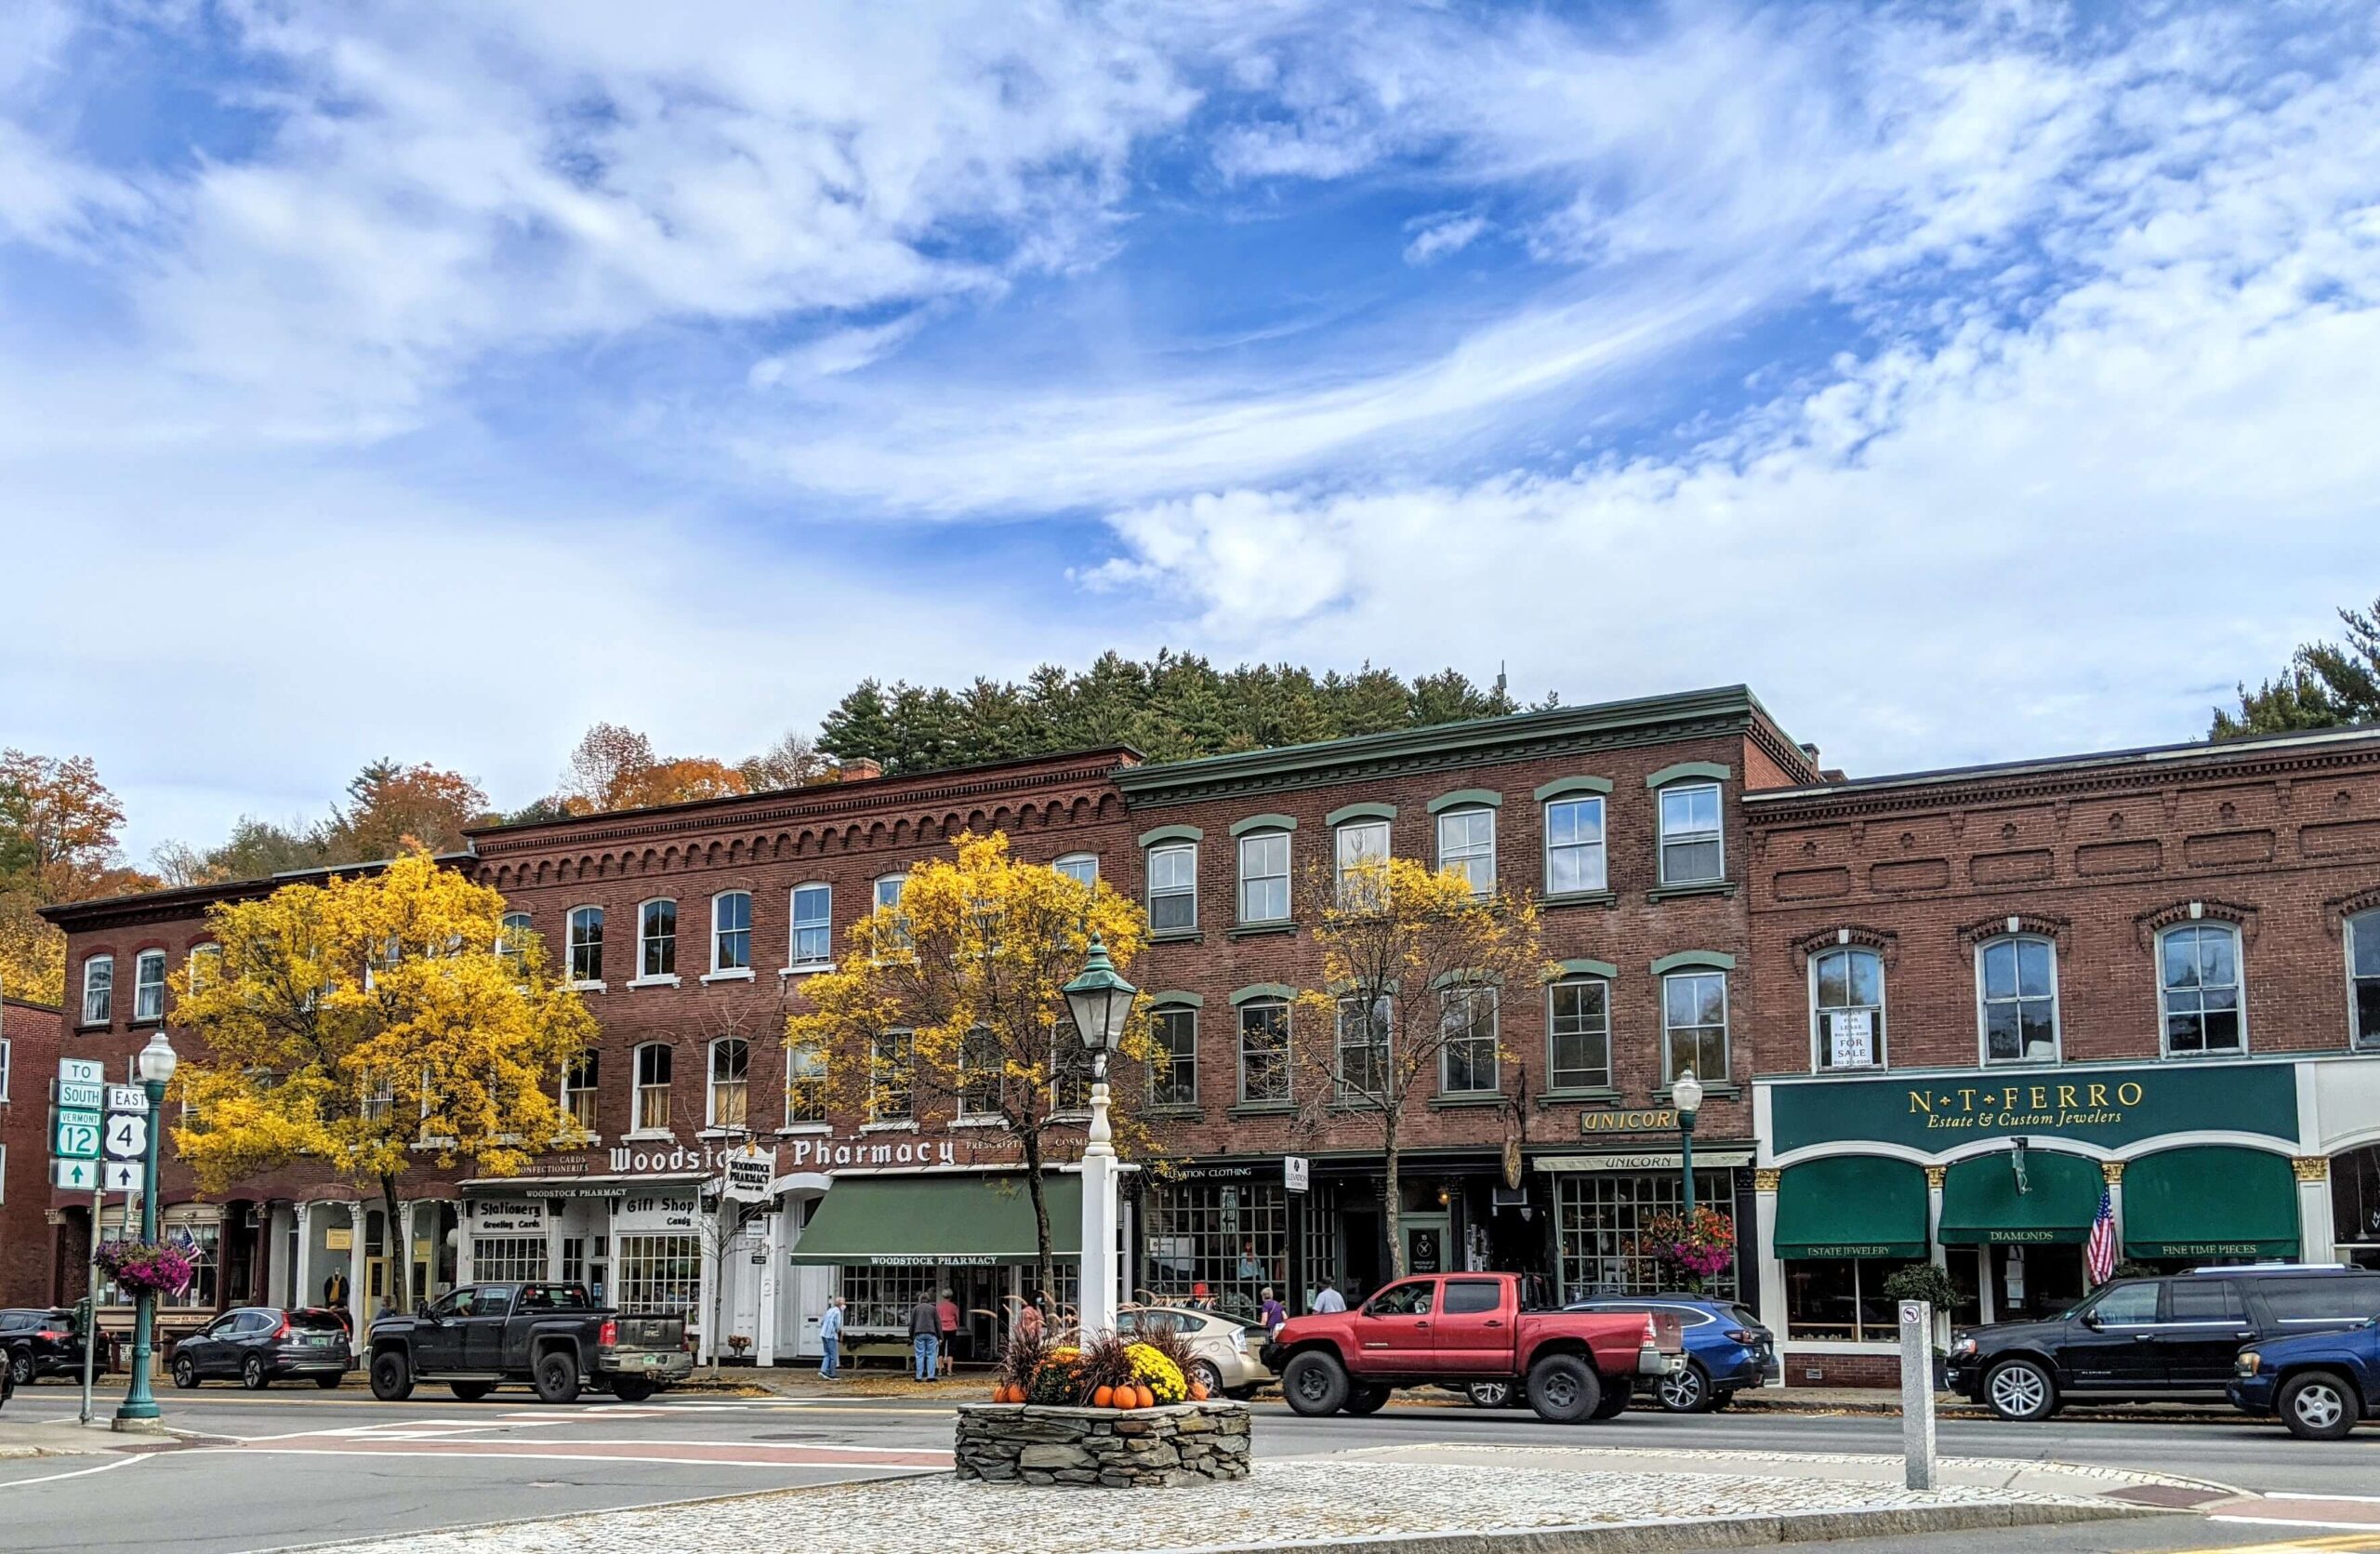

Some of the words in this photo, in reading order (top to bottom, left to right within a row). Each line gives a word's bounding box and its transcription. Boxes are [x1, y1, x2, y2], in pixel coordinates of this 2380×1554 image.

[1840, 1039, 1863, 1047] FOR
[1837, 1049, 1866, 1057] SALE
[72, 1065, 91, 1078] TO
[63, 1086, 99, 1104] SOUTH
[115, 1091, 145, 1106] EAST
[2003, 1082, 2143, 1110] FERRO
[62, 1112, 99, 1123] VERMONT
[1927, 1114, 1974, 1128] Estate
[1978, 1112, 1994, 1126] &
[1998, 1112, 2054, 1126] Custom
[2056, 1109, 2122, 1127] Jewelers
[67, 1126, 92, 1152] 12
[116, 1123, 133, 1148] 4
[966, 1139, 1043, 1149] PRESCRIPTIS
[1055, 1137, 1090, 1147] COSME
[609, 1145, 725, 1172] Woodsto
[792, 1139, 957, 1166] Pharmacy
[730, 1161, 771, 1174] WOODSTOCK
[1606, 1157, 1673, 1168] UNICORN
[730, 1172, 769, 1185] PHARMACY
[1164, 1169, 1206, 1179] ELEVATION
[1209, 1167, 1251, 1177] CLOTHING
[579, 1189, 628, 1197] PHARMACY
[480, 1201, 541, 1217] Stationery
[627, 1198, 654, 1213] Gift
[661, 1197, 694, 1215] Shop
[483, 1220, 513, 1230] Greeting
[518, 1220, 540, 1229] Cards
[667, 1216, 692, 1227] Candy
[1990, 1231, 2054, 1242] DIAMONDS
[1807, 1247, 1842, 1256] ESTATE
[1843, 1246, 1891, 1257] JEWELERY
[2162, 1245, 2188, 1255] FINE
[2189, 1244, 2216, 1255] TIME
[2218, 1244, 2256, 1254] PIECES
[871, 1256, 933, 1265] WOODSTOCK
[937, 1256, 997, 1265] PHARMACY
